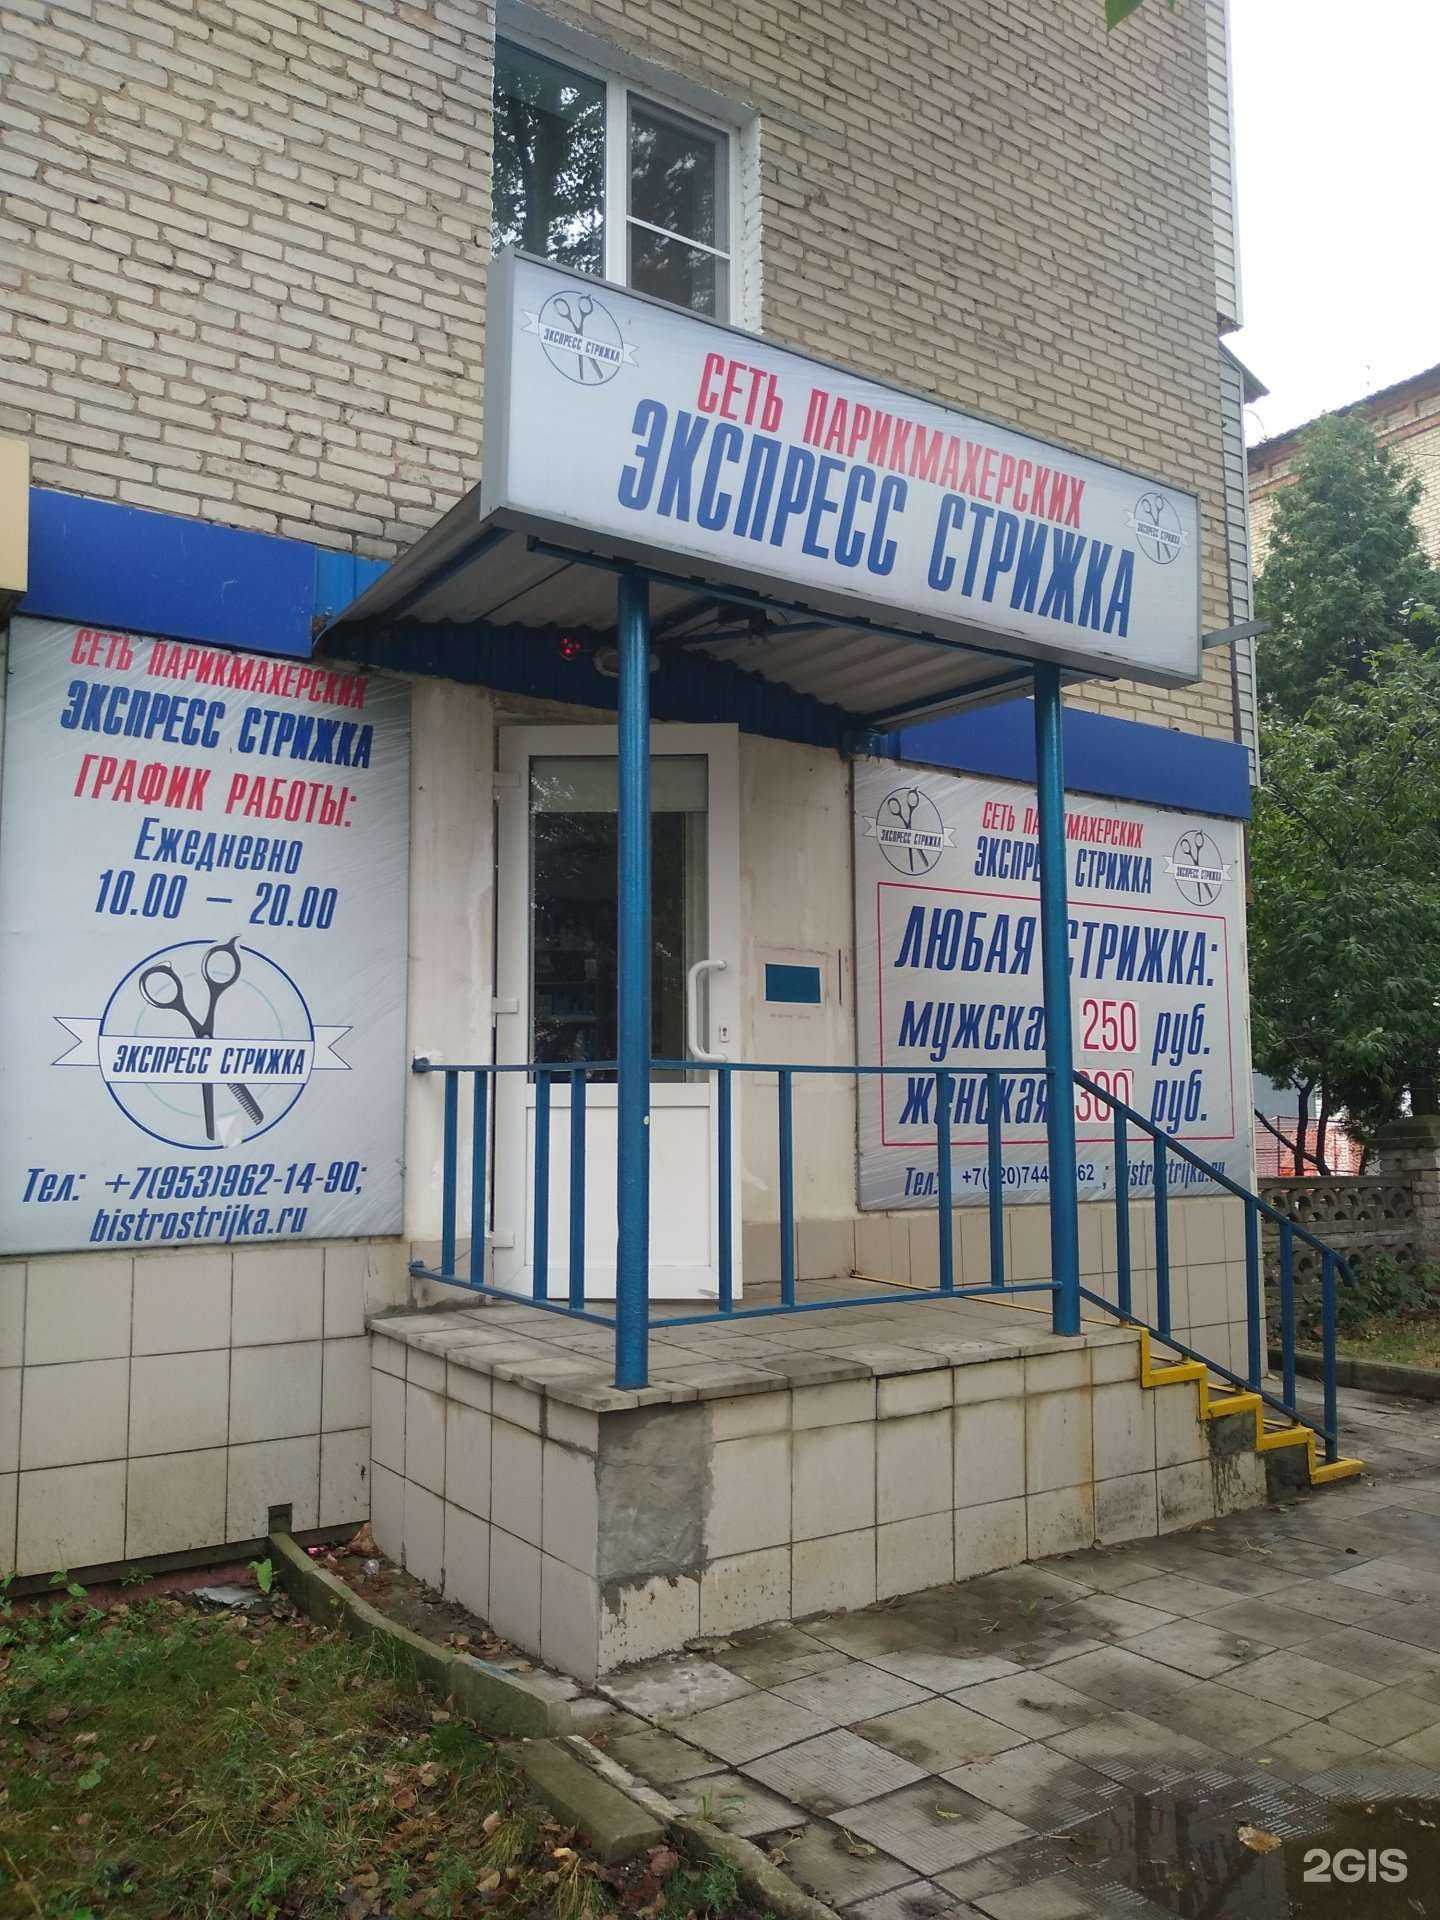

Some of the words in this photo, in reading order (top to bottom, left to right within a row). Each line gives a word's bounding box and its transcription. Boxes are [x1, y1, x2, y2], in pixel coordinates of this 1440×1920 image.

[543, 328, 582, 351] ЭКСПРЕСС
[585, 341, 620, 363] СТРИЖКА
[697, 352, 784, 433] СЕТЬ
[802, 388, 1086, 529] ПАРИКМАХЕРСКИХ
[617, 398, 908, 577] ЭКСПРЕСС
[927, 493, 1135, 638] СТРИЖКА
[70, 628, 135, 671] СЕТЬ
[147, 642, 369, 709] ПАРИКМАХЕРСКИХ
[60, 679, 226, 749] ЭКСПРЕСС
[237, 707, 374, 769] СТРИЖКА
[74, 753, 211, 811] ГРАФИК
[225, 773, 357, 827] РАБОТЫ:
[134, 816, 303, 874] Ежедневно
[881, 829, 912, 844] ЭКСПРЕСС
[914, 833, 942, 848] СТРИЖКА
[982, 801, 1015, 832] СЕТЬ
[1023, 807, 1144, 849] ПАМАХЕРСКИХ
[974, 835, 1041, 882] ЭКСПРЕ
[1075, 848, 1152, 894] СТРИЖКА
[95, 869, 188, 919] 10.00
[249, 882, 338, 929] 20.00
[894, 905, 1036, 975] ЛЮБАЯ
[112, 1044, 212, 1075] ЭКСПРЕСС
[220, 1048, 306, 1075] СТРИЖКА
[1082, 999, 1136, 1052] 250
[1151, 1003, 1210, 1066] руб.
[1151, 1069, 1207, 1135] руб.
[22, 1168, 86, 1202] Тел:
[104, 1161, 367, 1200] +7(953)962-14-90;
[89, 1205, 308, 1244] bistrostrijka.ru
